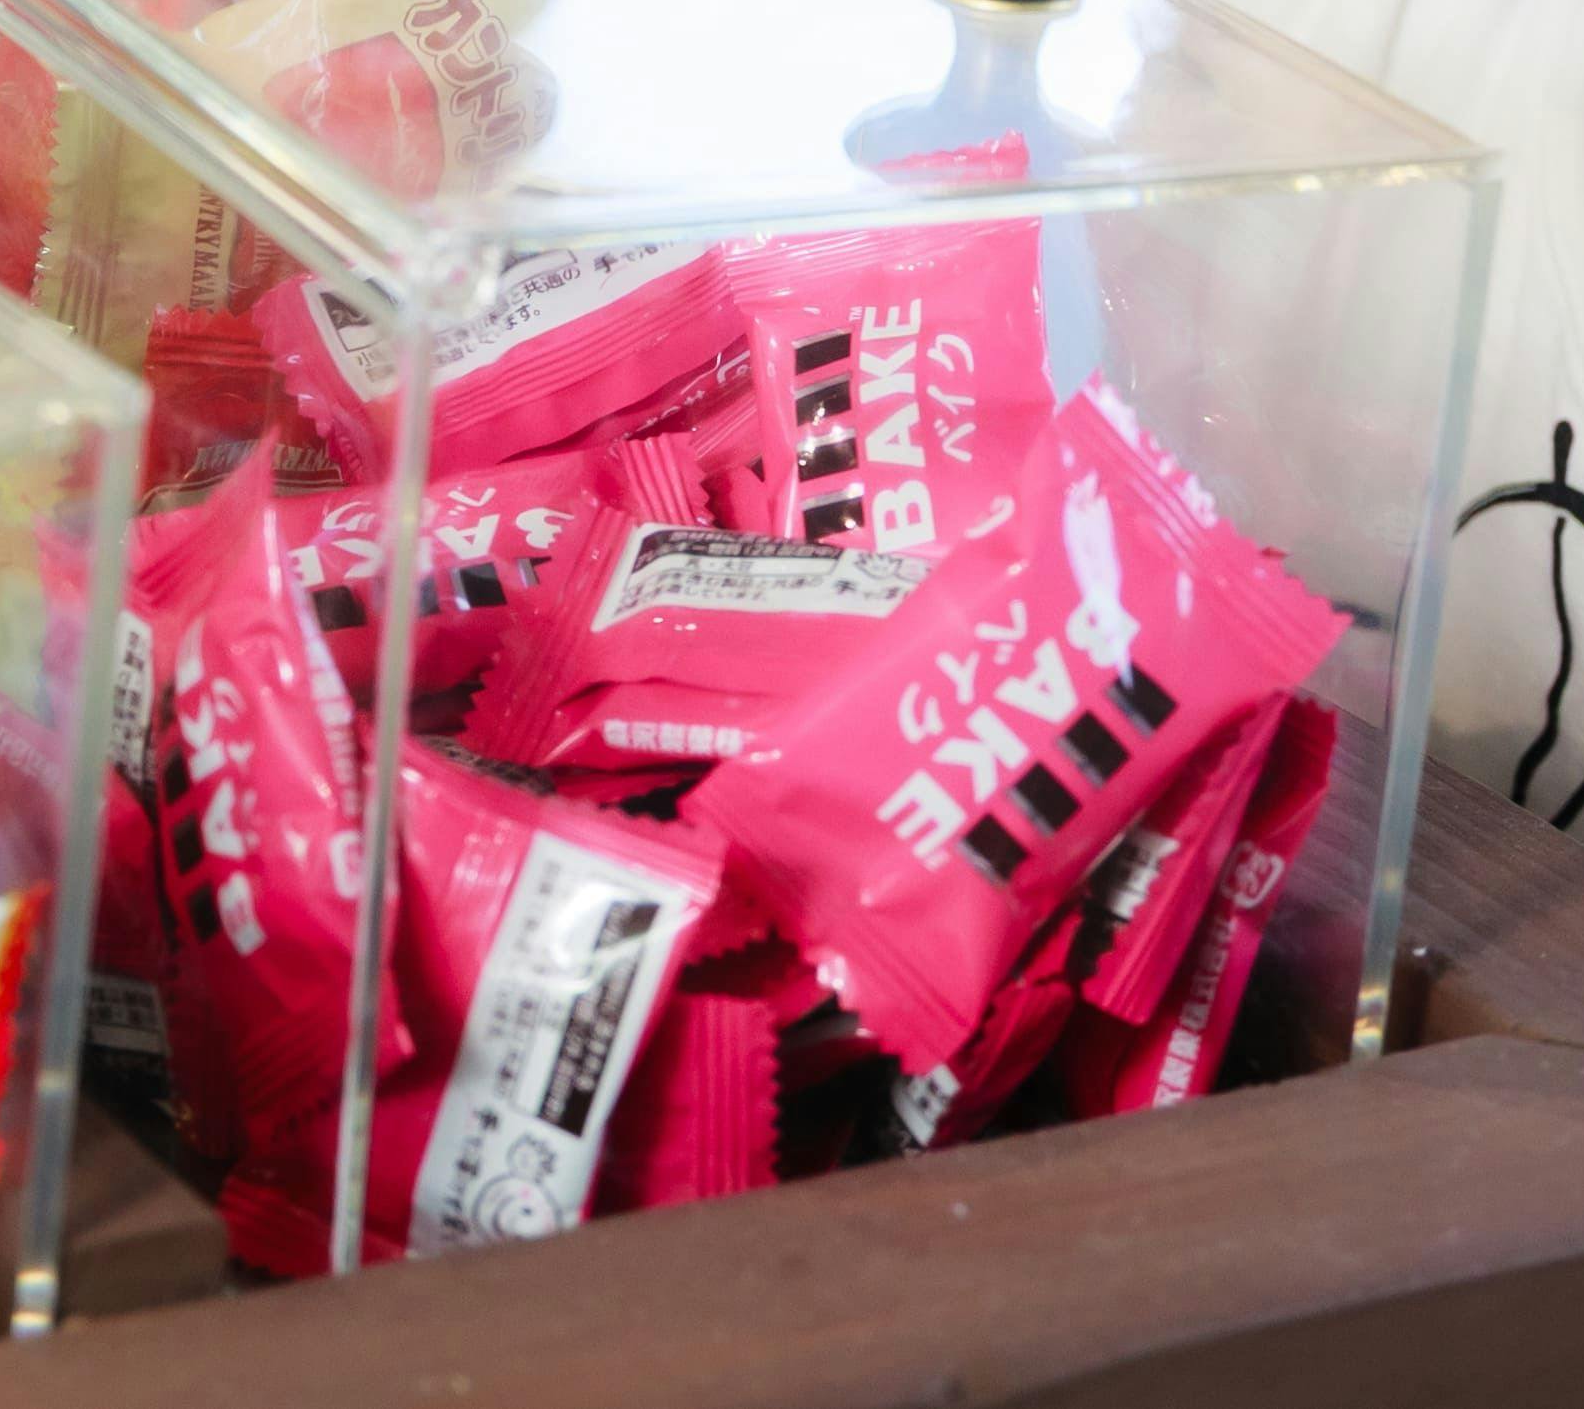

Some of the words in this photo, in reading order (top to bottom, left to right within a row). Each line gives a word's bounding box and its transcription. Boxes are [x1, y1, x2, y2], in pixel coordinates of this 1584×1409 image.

[194, 190, 225, 249] NTRY
[859, 297, 938, 556] BAKE
[926, 331, 976, 463] ベイク
[288, 503, 576, 586] BAKE
[323, 484, 497, 532] ベク
[876, 599, 1141, 862] BAKE
[897, 600, 1027, 745] ベイク
